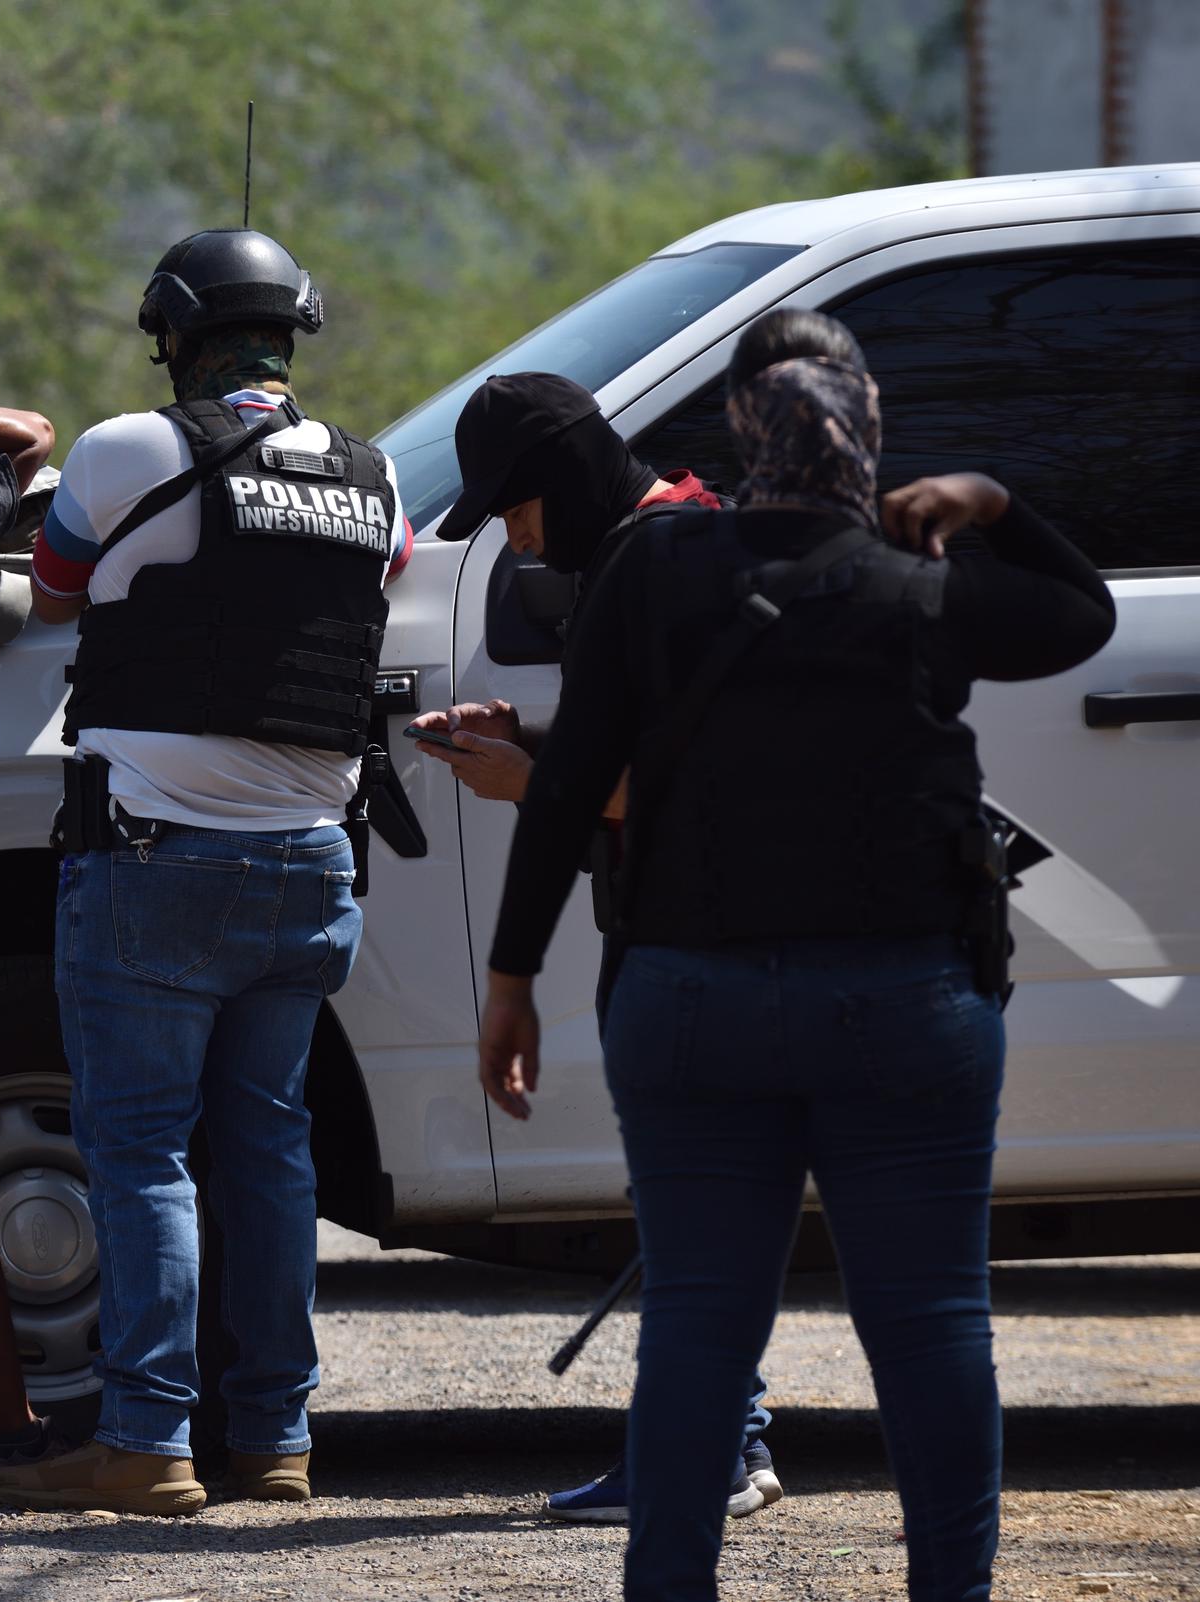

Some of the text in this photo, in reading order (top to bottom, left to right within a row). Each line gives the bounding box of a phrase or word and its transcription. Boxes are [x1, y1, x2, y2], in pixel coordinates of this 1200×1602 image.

[229, 476, 388, 529] POLICÍA
[237, 506, 388, 553] INVESTIGADORA
[374, 678, 410, 694] 50
